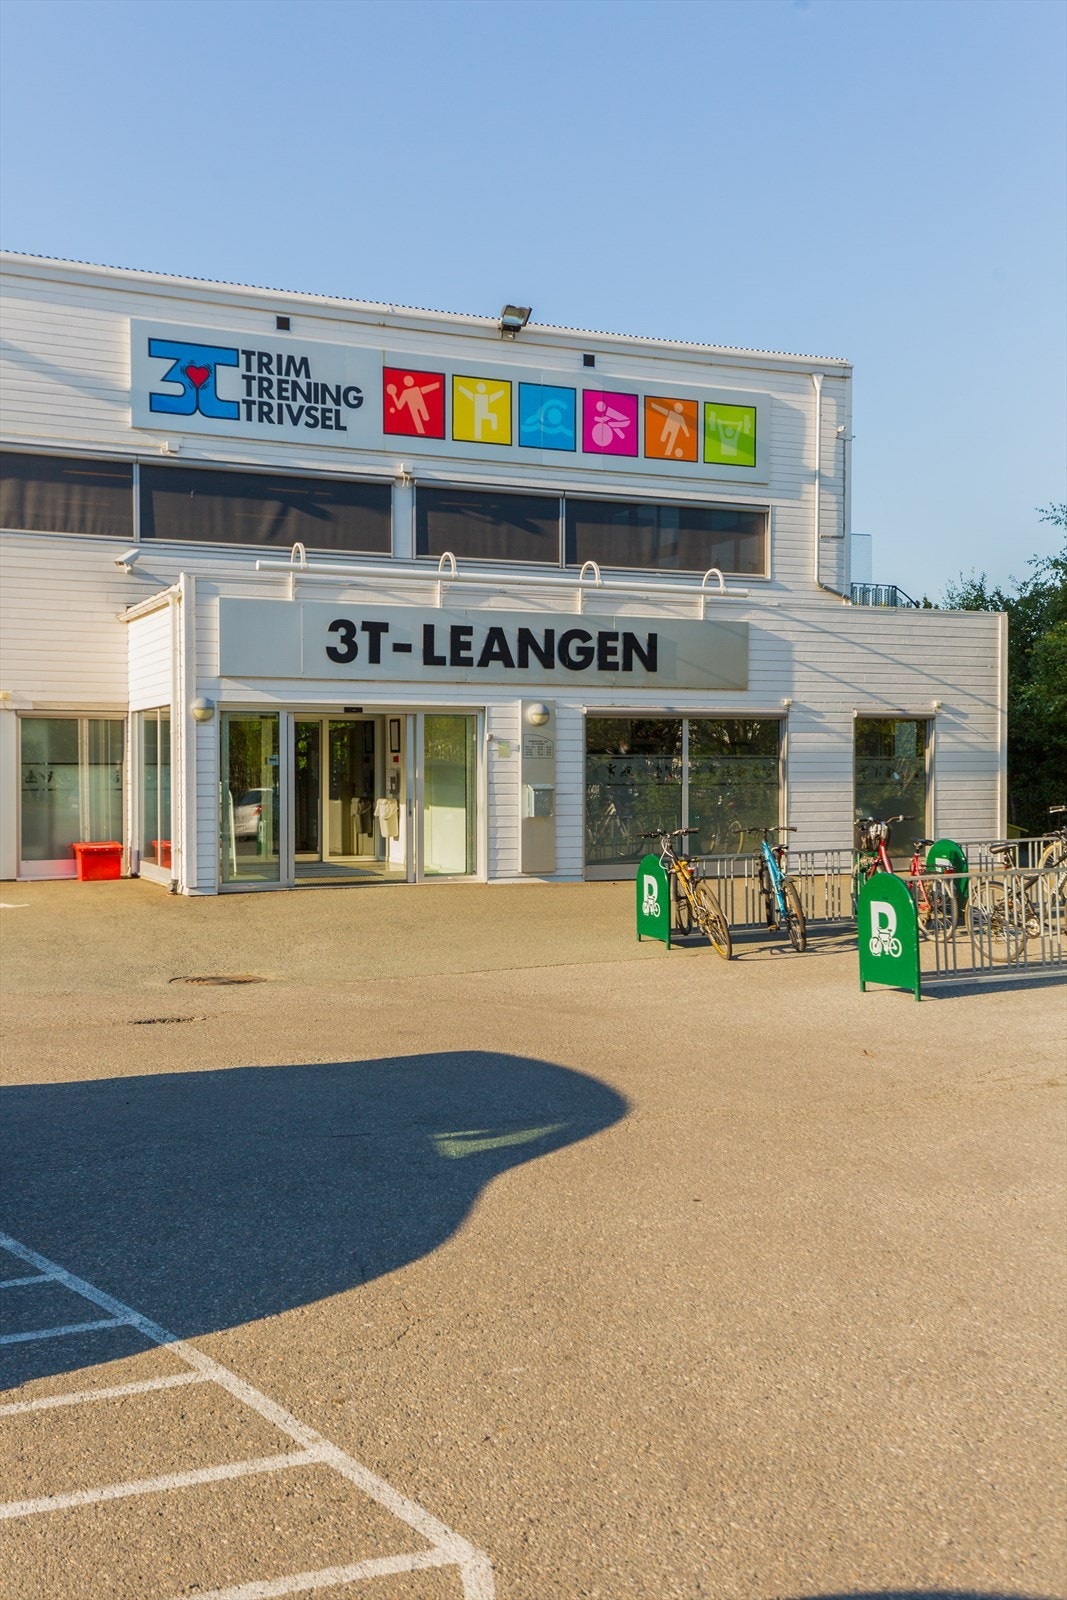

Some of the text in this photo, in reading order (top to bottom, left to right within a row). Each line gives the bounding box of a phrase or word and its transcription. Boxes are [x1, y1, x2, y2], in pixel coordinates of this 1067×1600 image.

[241, 350, 312, 379] TRIM
[241, 374, 364, 409] TRENING
[241, 398, 348, 432] TRIVSEL
[325, 618, 659, 673] 3T-LEANGEN
